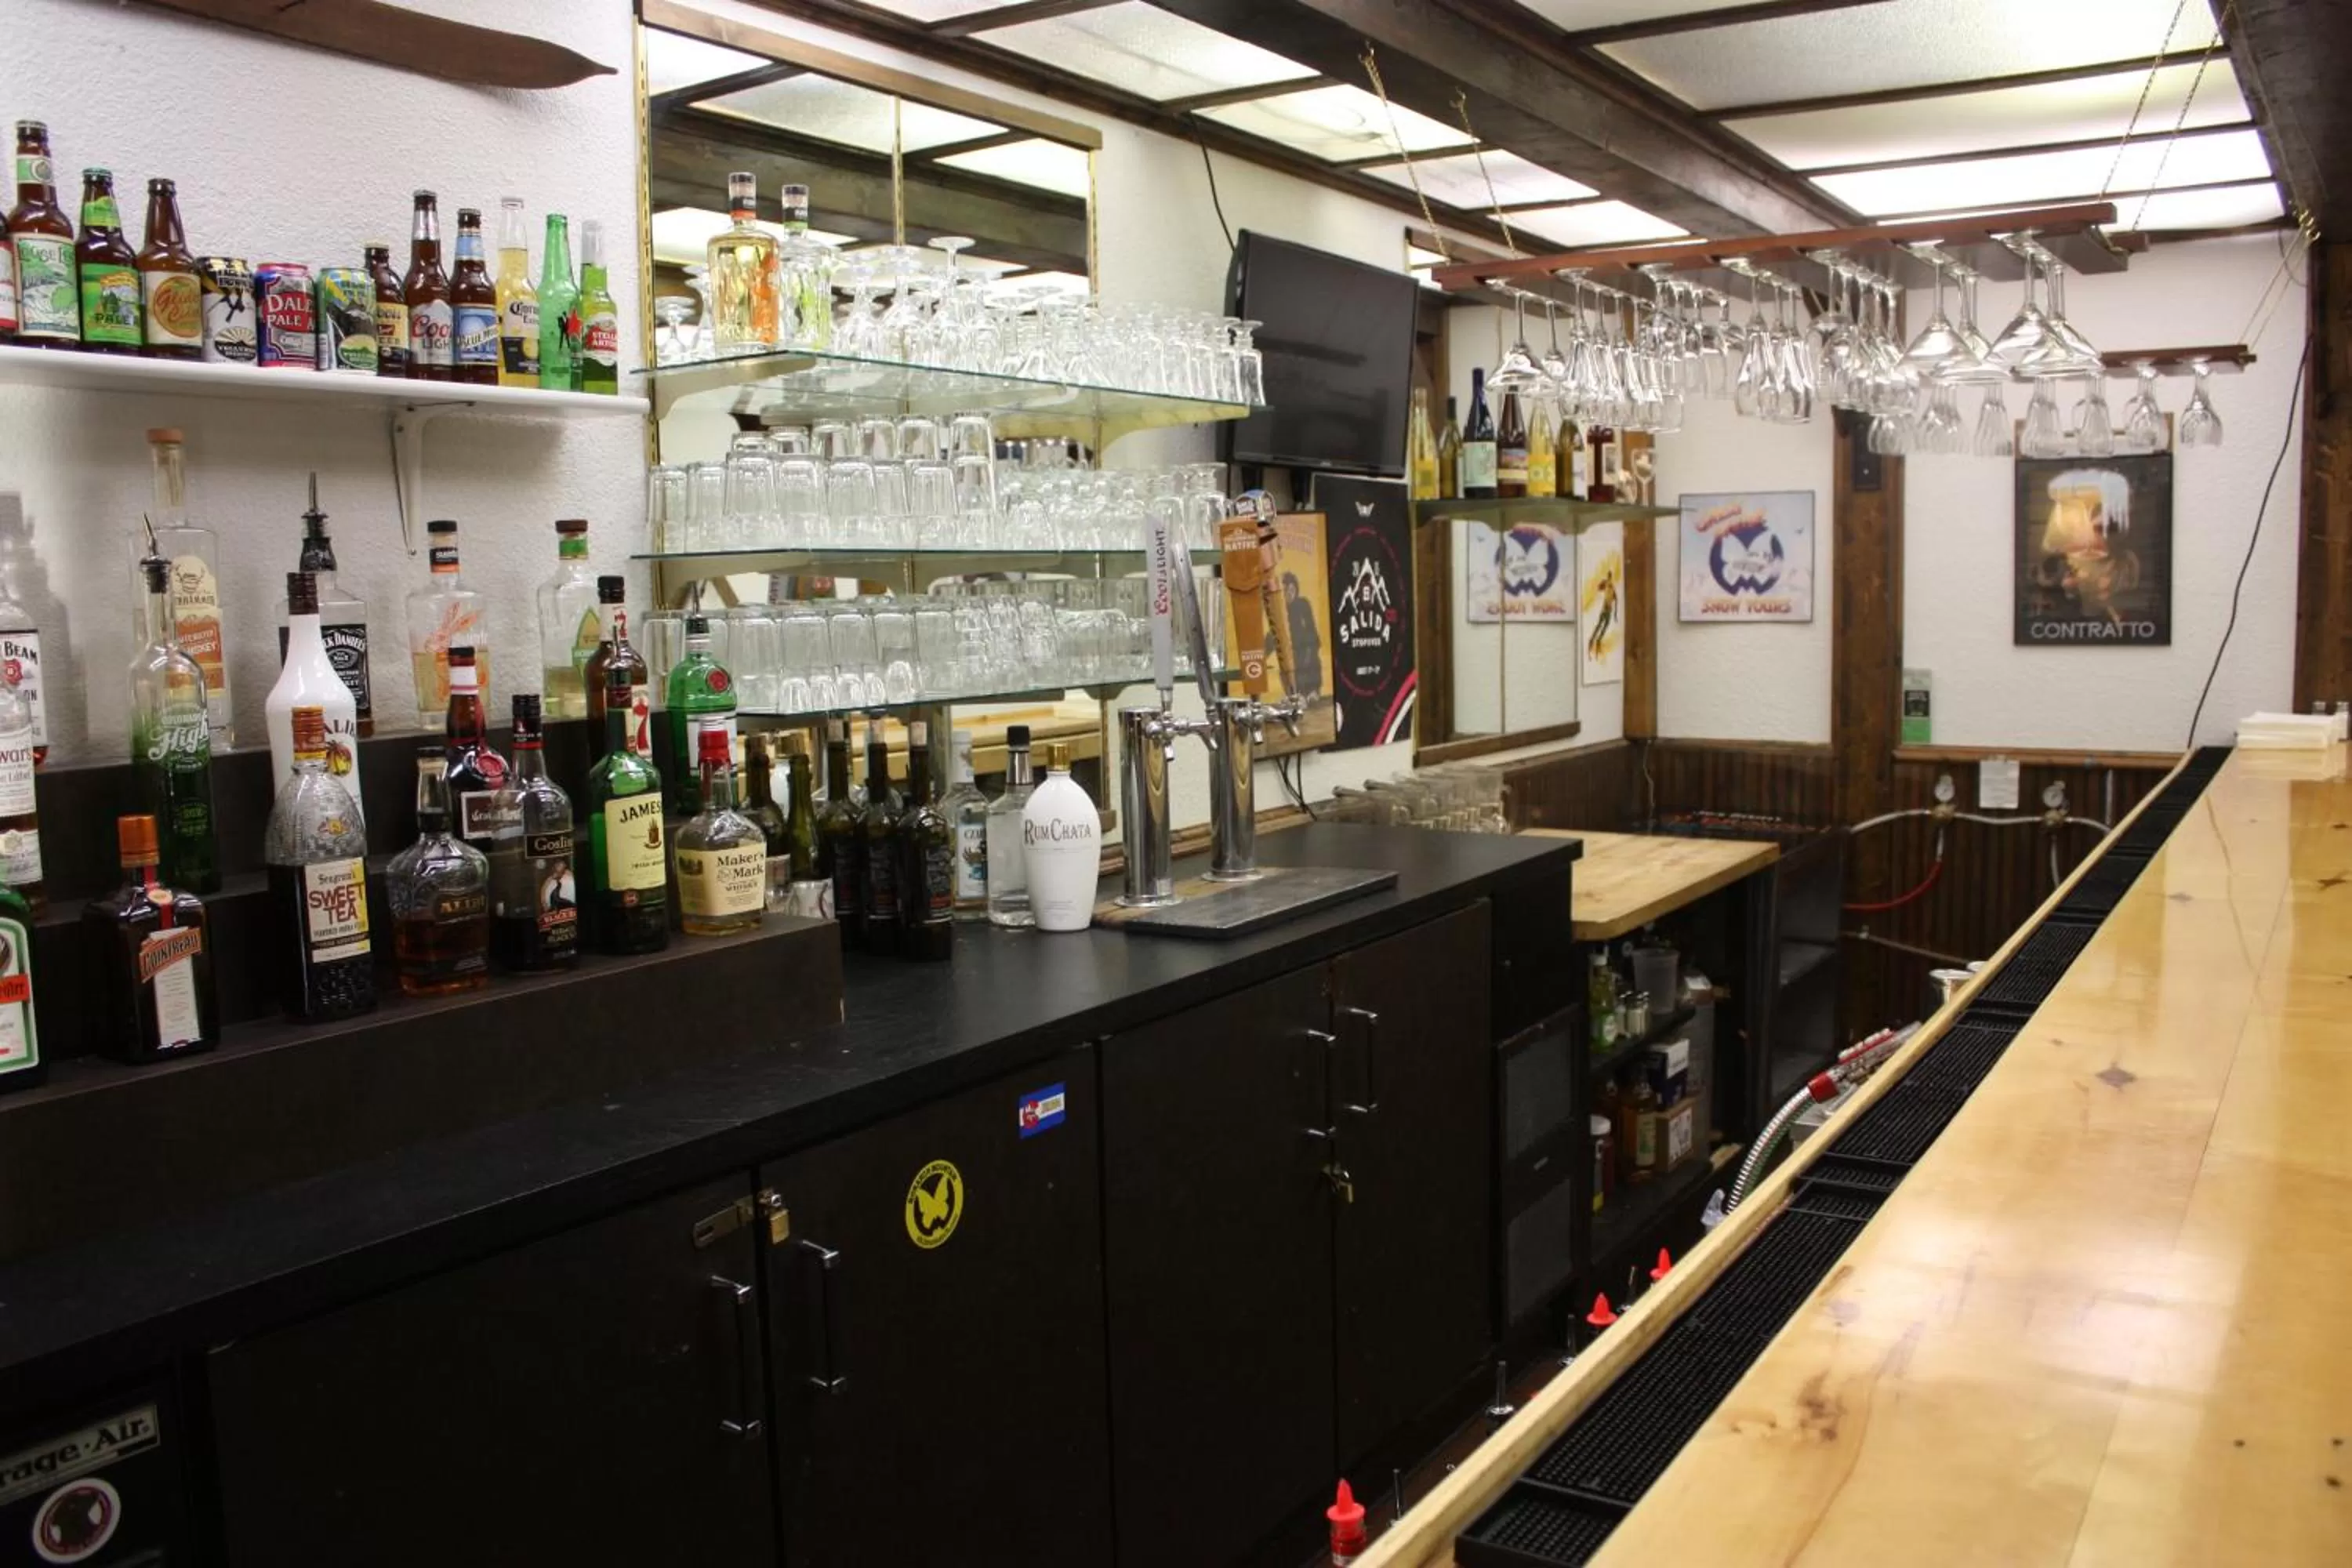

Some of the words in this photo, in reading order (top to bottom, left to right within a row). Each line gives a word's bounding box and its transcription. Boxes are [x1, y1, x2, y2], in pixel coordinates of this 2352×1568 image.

[267, 294, 314, 312] DALE
[266, 314, 303, 326] PALE
[411, 314, 451, 338] Coo
[422, 338, 451, 349] LIGH
[1155, 529, 1167, 568] LIGHT
[1339, 609, 1391, 644] SALIDA
[2030, 620, 2155, 639] CONTRATTO
[4, 641, 38, 666] BEAM
[147, 707, 210, 761] High
[619, 800, 662, 824] JAMES
[717, 852, 764, 867] Maker's
[733, 864, 764, 879] Mark
[308, 881, 365, 909] SWEET
[323, 902, 358, 926] TEA
